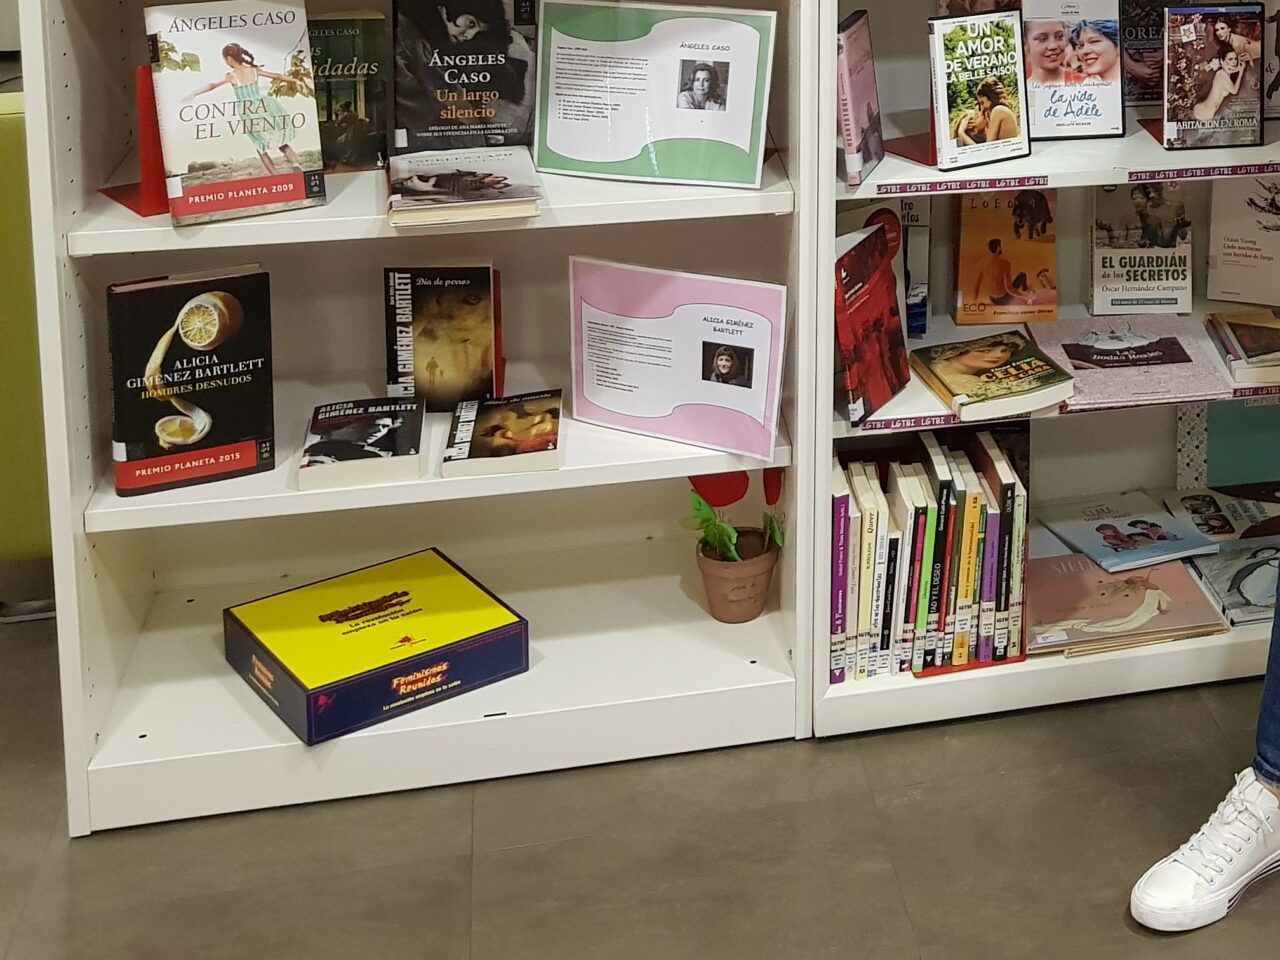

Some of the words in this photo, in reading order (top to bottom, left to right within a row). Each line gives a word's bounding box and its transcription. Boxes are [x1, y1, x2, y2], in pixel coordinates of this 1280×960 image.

[169, 14, 246, 33] ÁNGELES
[252, 11, 296, 25] CASO
[968, 22, 990, 37] UN
[680, 42, 710, 50] ÁNGELES
[956, 36, 1004, 56] AMOR
[429, 50, 505, 67] ÁNGELES
[946, 60, 962, 72] DE
[965, 52, 1017, 70] VERANO
[444, 69, 490, 84] CASO
[436, 89, 457, 102] Un
[462, 89, 499, 104] largo
[1069, 89, 1096, 102] vida
[180, 97, 267, 122] CONTRA
[440, 105, 495, 120] silencio
[1044, 104, 1060, 118] de
[1065, 100, 1101, 118] Adèle
[195, 122, 223, 139] EL
[228, 113, 306, 136] VIENTO
[188, 192, 224, 203] PREMIO
[228, 187, 268, 197] PLANETA
[272, 184, 294, 193] 2009
[937, 182, 960, 190] LGTBI
[1102, 257, 1114, 268] EL
[1119, 252, 1186, 269] GUARDIÁN
[1126, 269, 1187, 281] SECRETOS
[395, 272, 413, 322] BARTLETT
[394, 326, 414, 373] GIMÉNEZ
[173, 354, 219, 369] ALICIA
[195, 358, 264, 379] BARTLETT
[141, 382, 193, 399] HOMBRES
[196, 374, 252, 393] DESNUDOS
[136, 463, 172, 476] PREMIO
[175, 456, 216, 470] PLANETA
[219, 452, 240, 462] 2015
[393, 662, 447, 688] Feminismos
[400, 674, 442, 694] Reunidos
